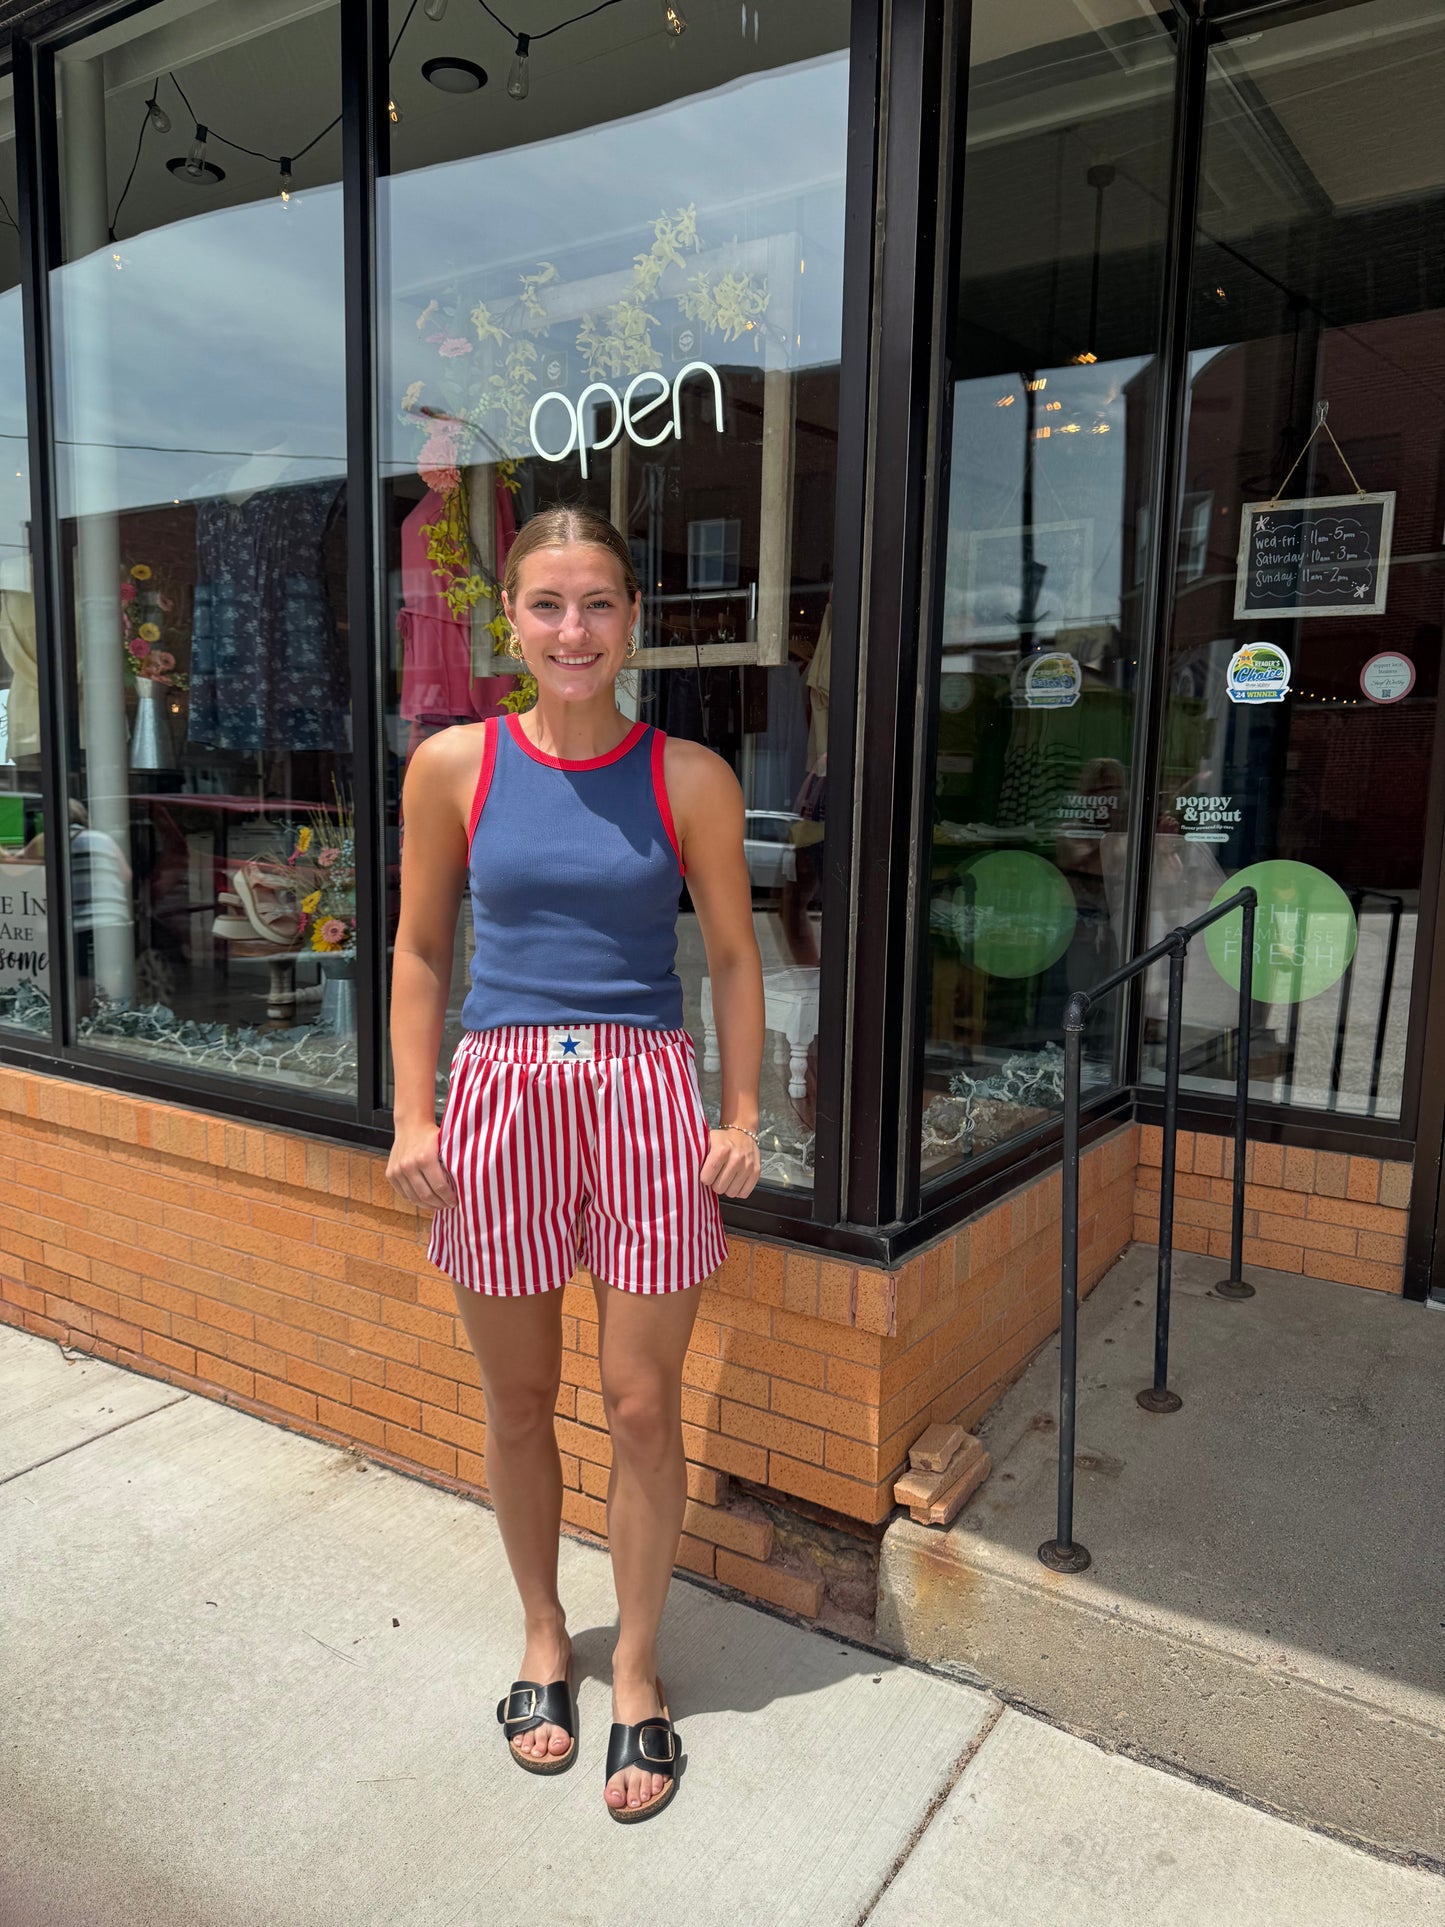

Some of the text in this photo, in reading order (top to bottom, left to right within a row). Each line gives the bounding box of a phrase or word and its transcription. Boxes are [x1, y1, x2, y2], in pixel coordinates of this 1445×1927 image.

[530, 361, 724, 480] open
[1235, 666, 1283, 683] Choice
[1175, 796, 1232, 811] poppy
[0, 922, 34, 941] ARE
[1224, 927, 1334, 944] FAMHOUSE
